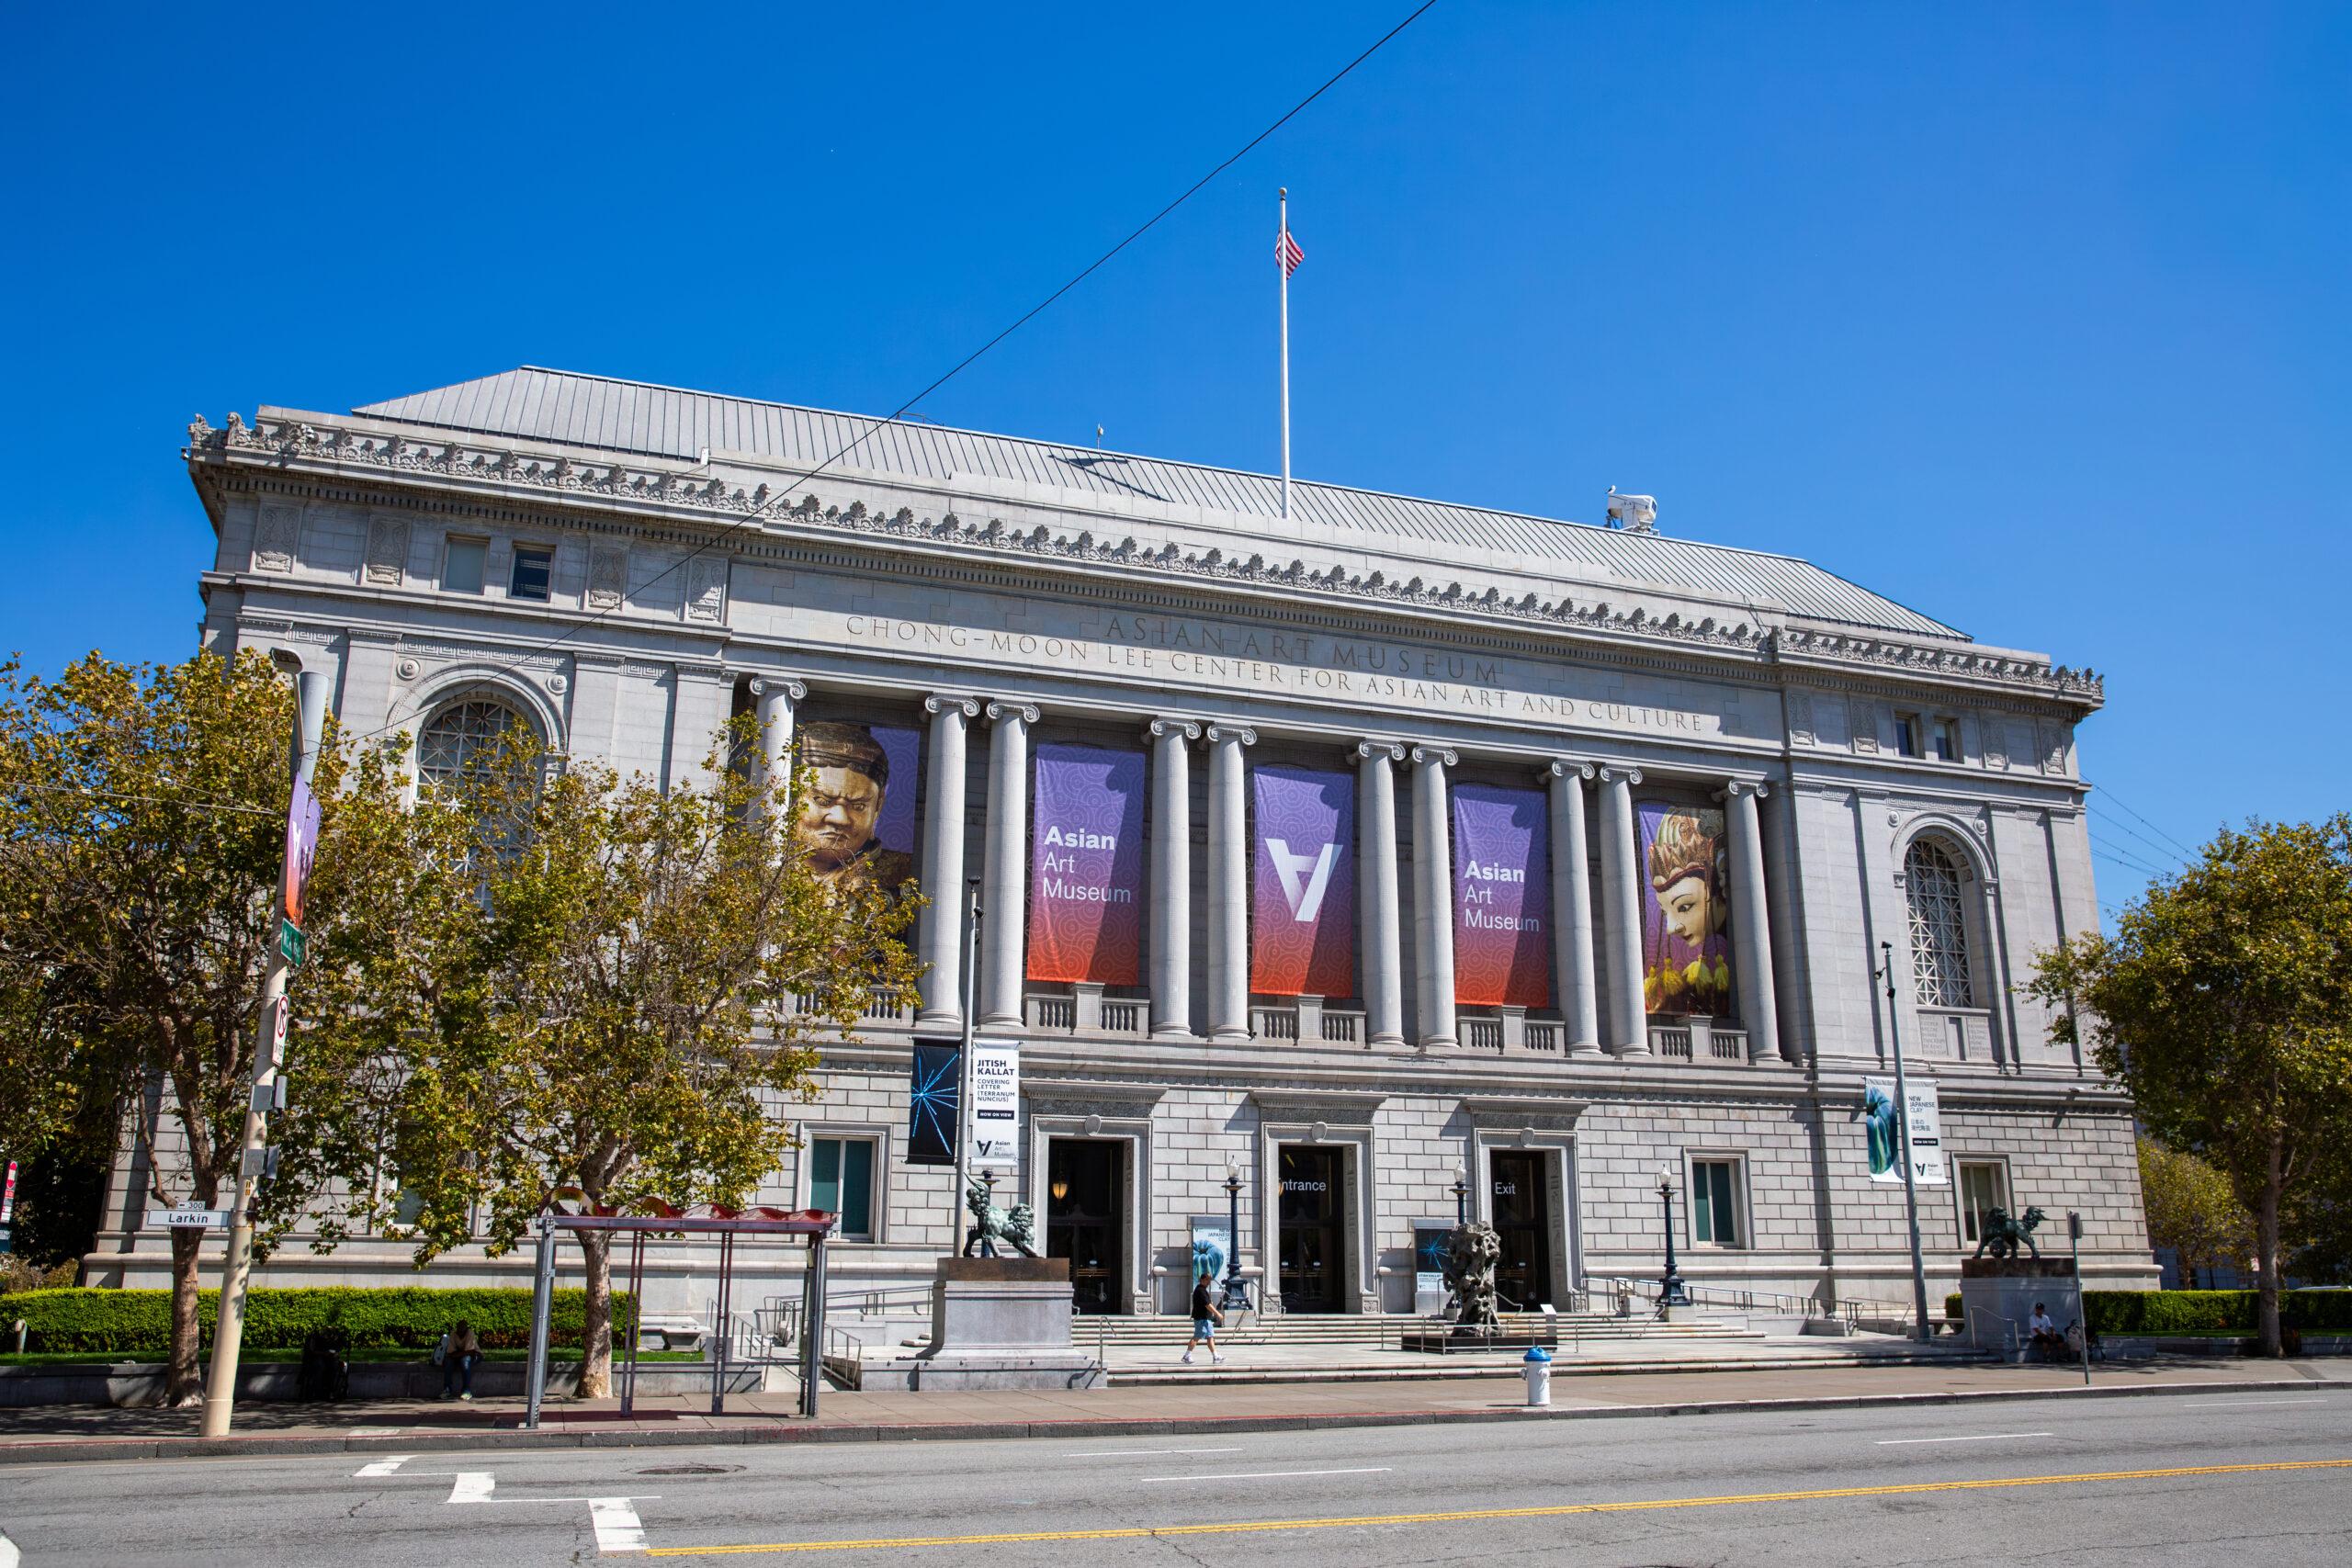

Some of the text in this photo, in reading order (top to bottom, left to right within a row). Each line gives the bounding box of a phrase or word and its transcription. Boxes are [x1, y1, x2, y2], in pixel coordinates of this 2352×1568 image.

[1107, 615, 1498, 683] ASIAN ART MUSEUM
[847, 615, 1702, 731] CHONG-MOON LEE CENTER FOR ASIAN ART AND CULTURE
[1044, 826, 1115, 850] Asian
[1043, 852, 1075, 874] Art
[1464, 861, 1525, 883] Asian
[1043, 877, 1131, 903] Museum
[1464, 885, 1492, 905] Art
[1464, 908, 1540, 932] Museum
[978, 1059, 1006, 1067] JITISH
[978, 1067, 1014, 1076] KALLAT
[1279, 1178, 1326, 1190] ntrance
[1495, 1182, 1516, 1194] Exit
[168, 1213, 209, 1224] Larkin
